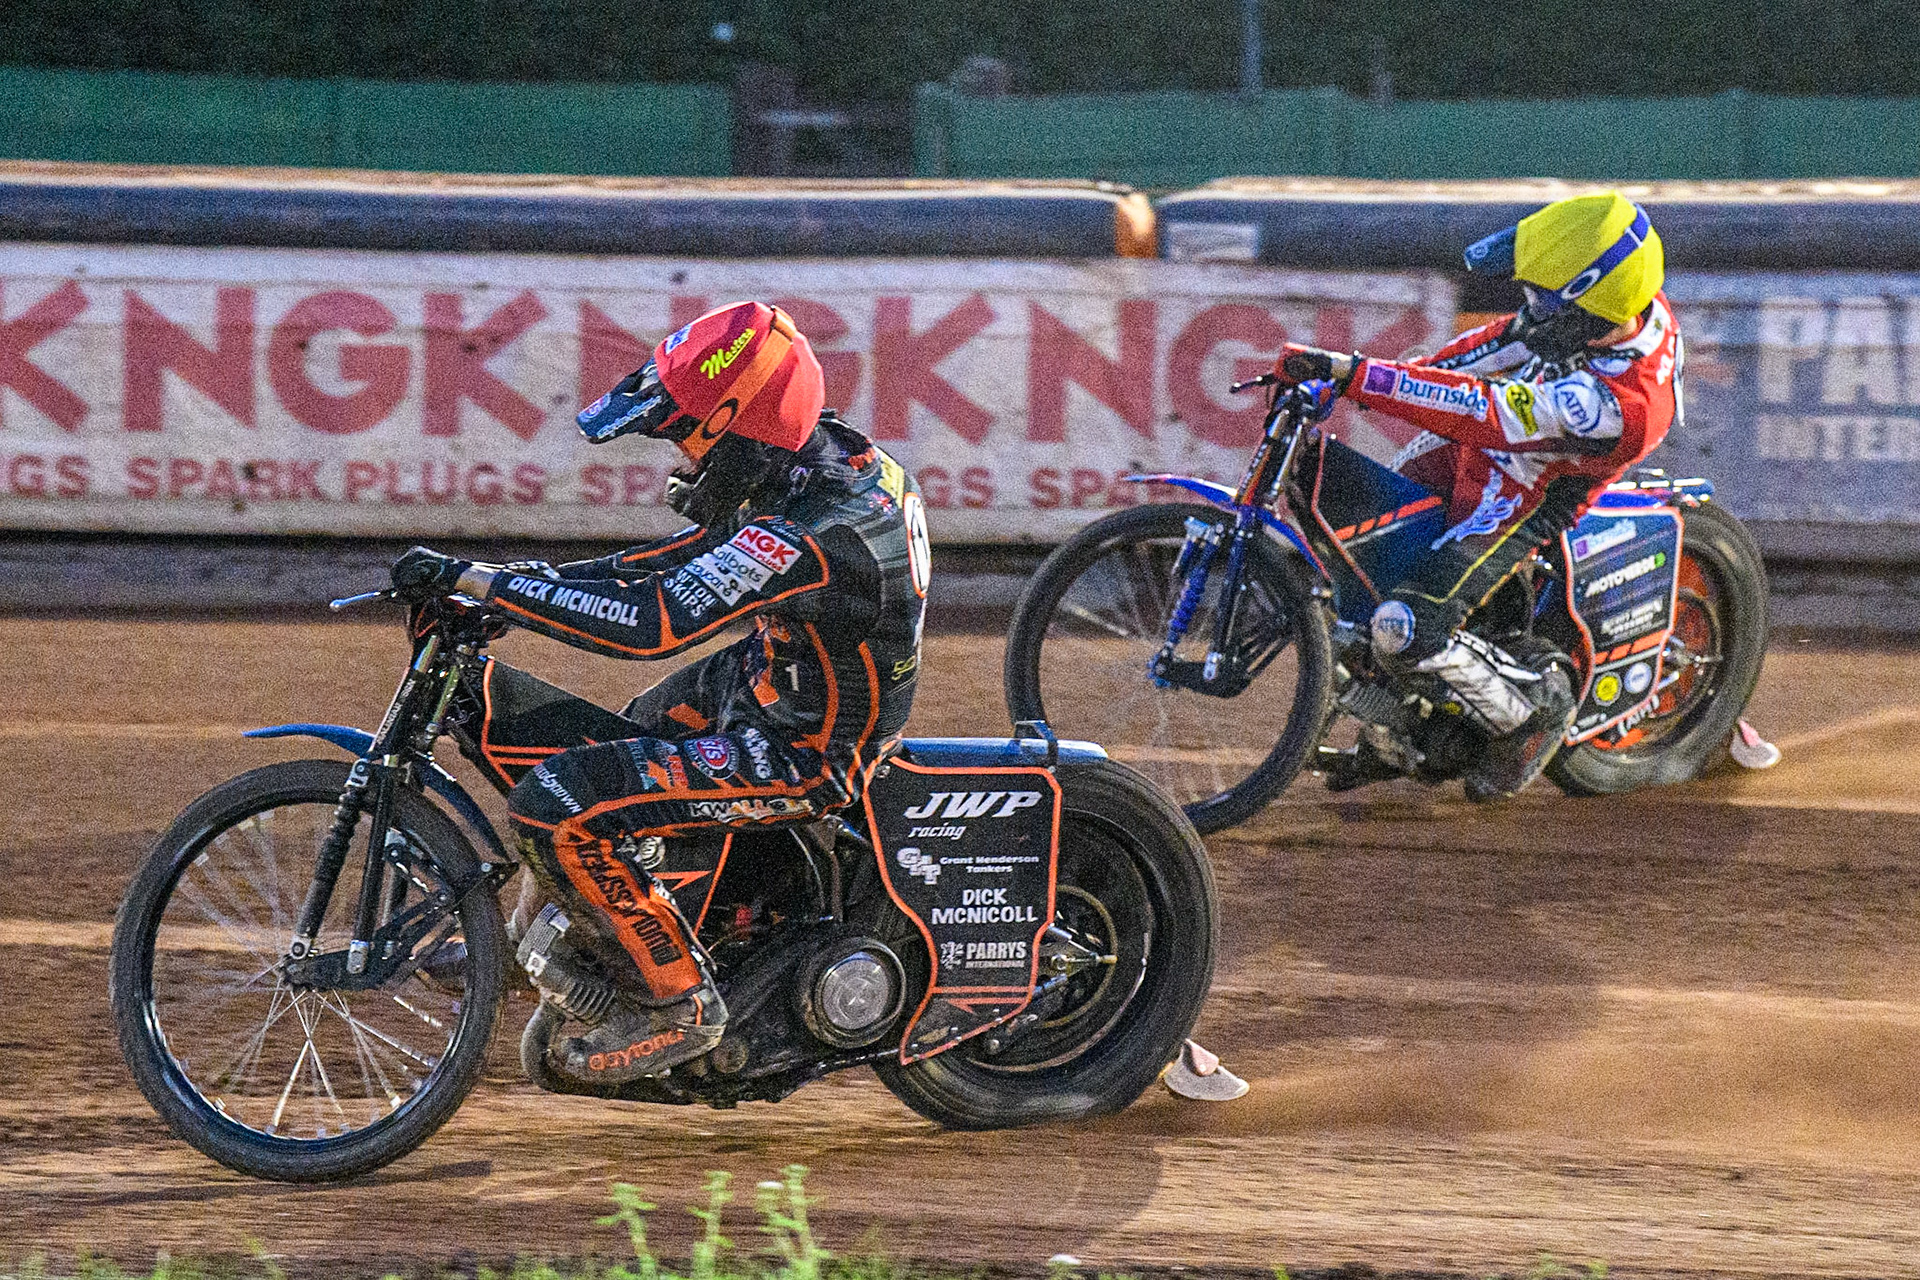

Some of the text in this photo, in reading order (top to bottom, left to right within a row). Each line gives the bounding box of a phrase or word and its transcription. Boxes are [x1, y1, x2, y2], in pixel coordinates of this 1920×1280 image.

[122, 287, 548, 441] NGK
[1399, 373, 1489, 414] burnside
[124, 456, 324, 502] SPARK
[345, 460, 547, 505] PLUGS
[737, 528, 796, 566] NGK
[507, 576, 640, 628] DICK MCNICOLL
[663, 577, 707, 618] SKIPS
[903, 791, 1043, 819] JWP
[908, 823, 966, 840] racing
[940, 856, 1039, 865] Grant Henderson
[965, 865, 1013, 873] Tankers
[962, 888, 1007, 906] DICK
[931, 906, 1039, 924] MCNICOLL
[966, 941, 1027, 960] PARRYS
